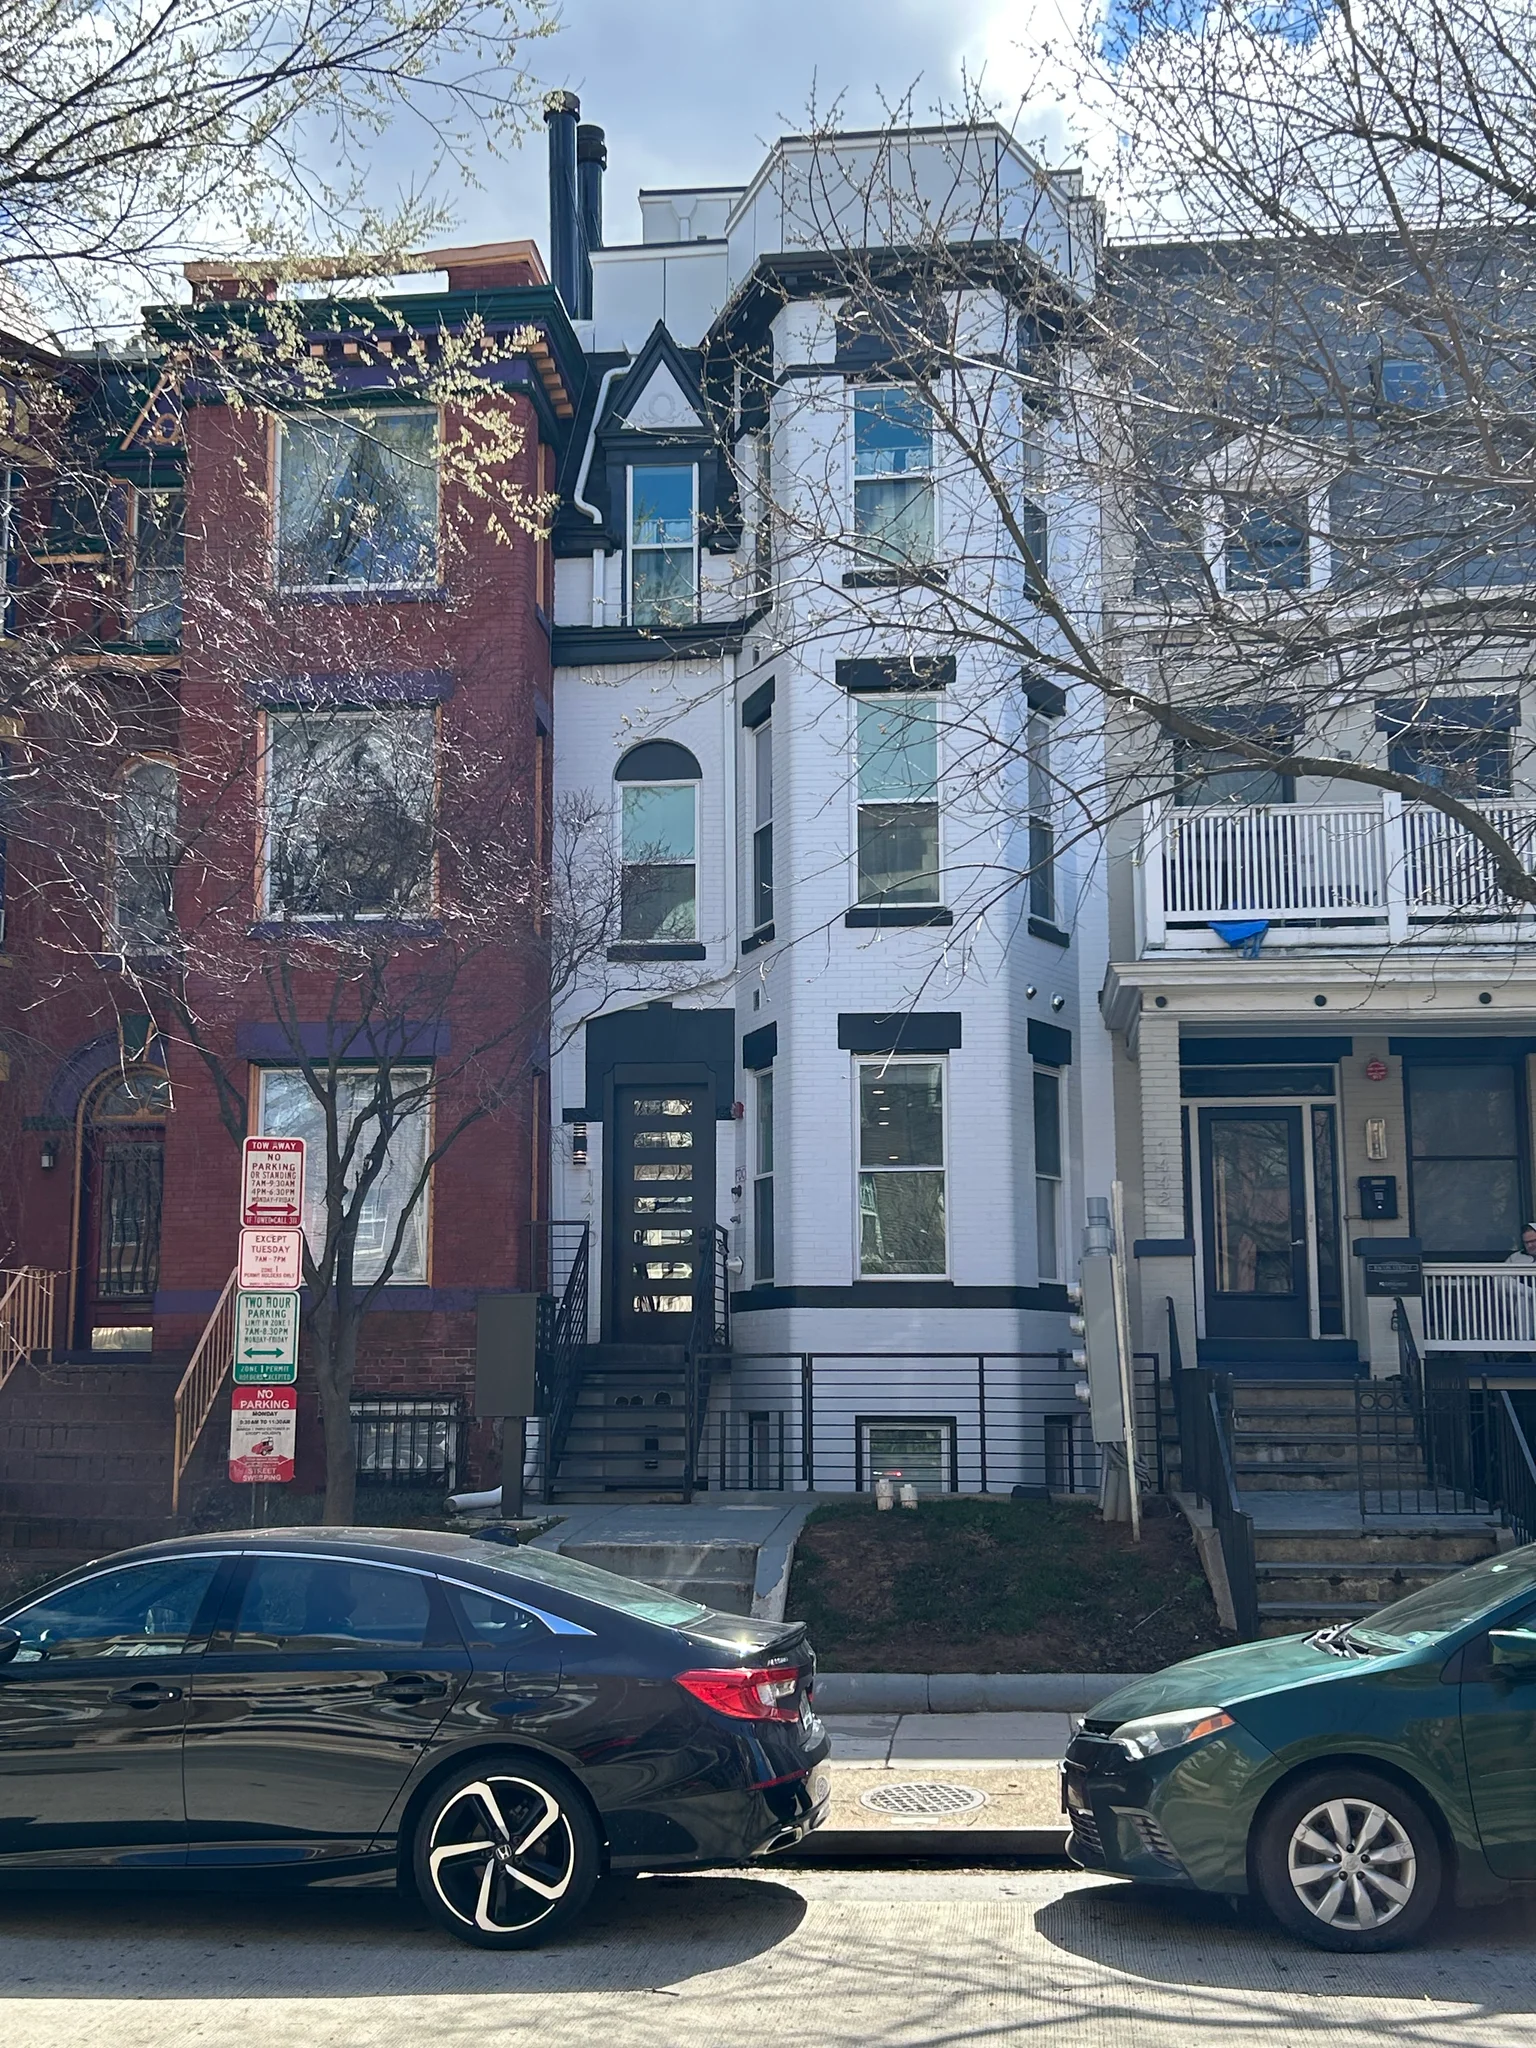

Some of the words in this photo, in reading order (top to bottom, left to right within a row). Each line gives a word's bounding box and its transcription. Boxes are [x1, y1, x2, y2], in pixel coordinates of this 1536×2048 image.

[272, 1142, 296, 1150] AWAY
[252, 1163, 295, 1171] PARKING
[245, 1296, 262, 1308] TWO
[266, 1296, 291, 1308] HOUR
[248, 1309, 286, 1318] PARKING
[258, 1390, 273, 1399] NO
[240, 1400, 290, 1409] PARKING
